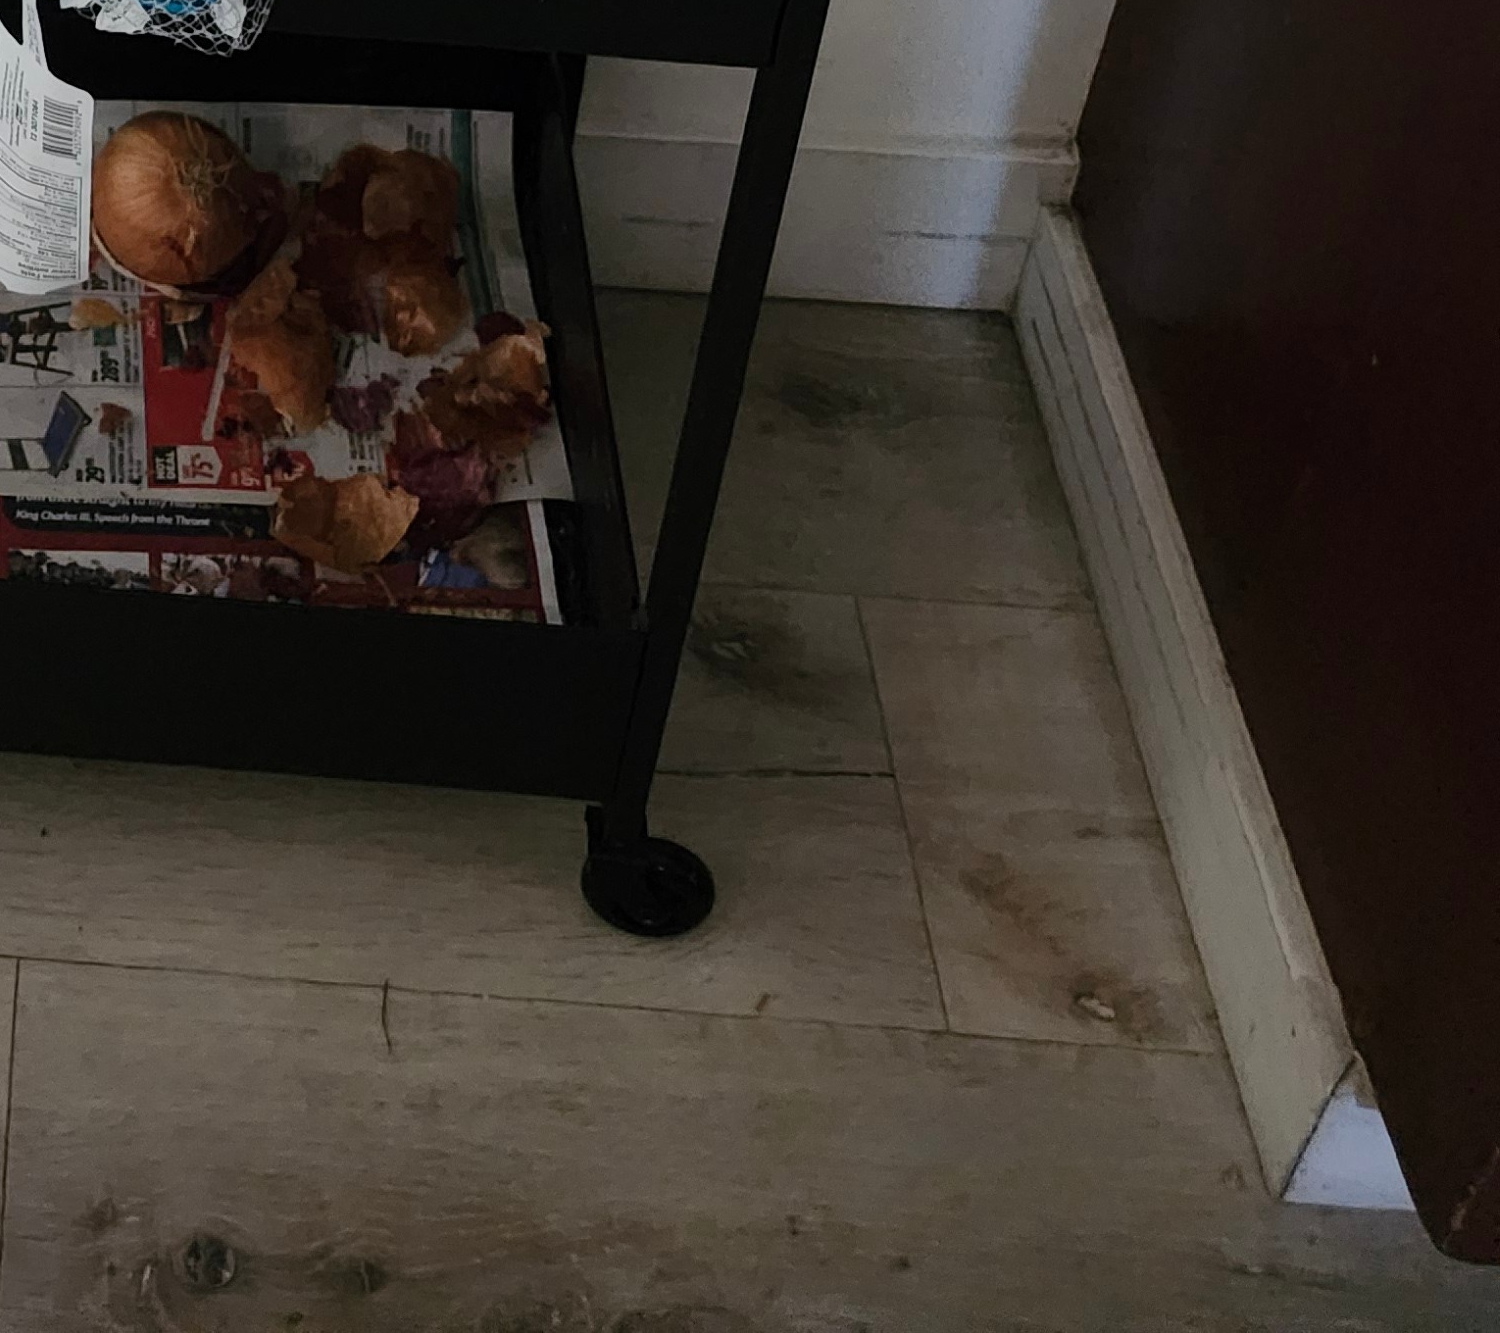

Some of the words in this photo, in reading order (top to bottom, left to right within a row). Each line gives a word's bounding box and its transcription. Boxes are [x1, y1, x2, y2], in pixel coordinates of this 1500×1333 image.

[155, 456, 167, 480] HOT
[165, 451, 177, 480] DEAL
[15, 509, 39, 522] King
[40, 510, 78, 522] Charles
[94, 512, 130, 524] Speech
[130, 513, 156, 524] from
[156, 514, 173, 525] the
[174, 515, 211, 526] Throne
